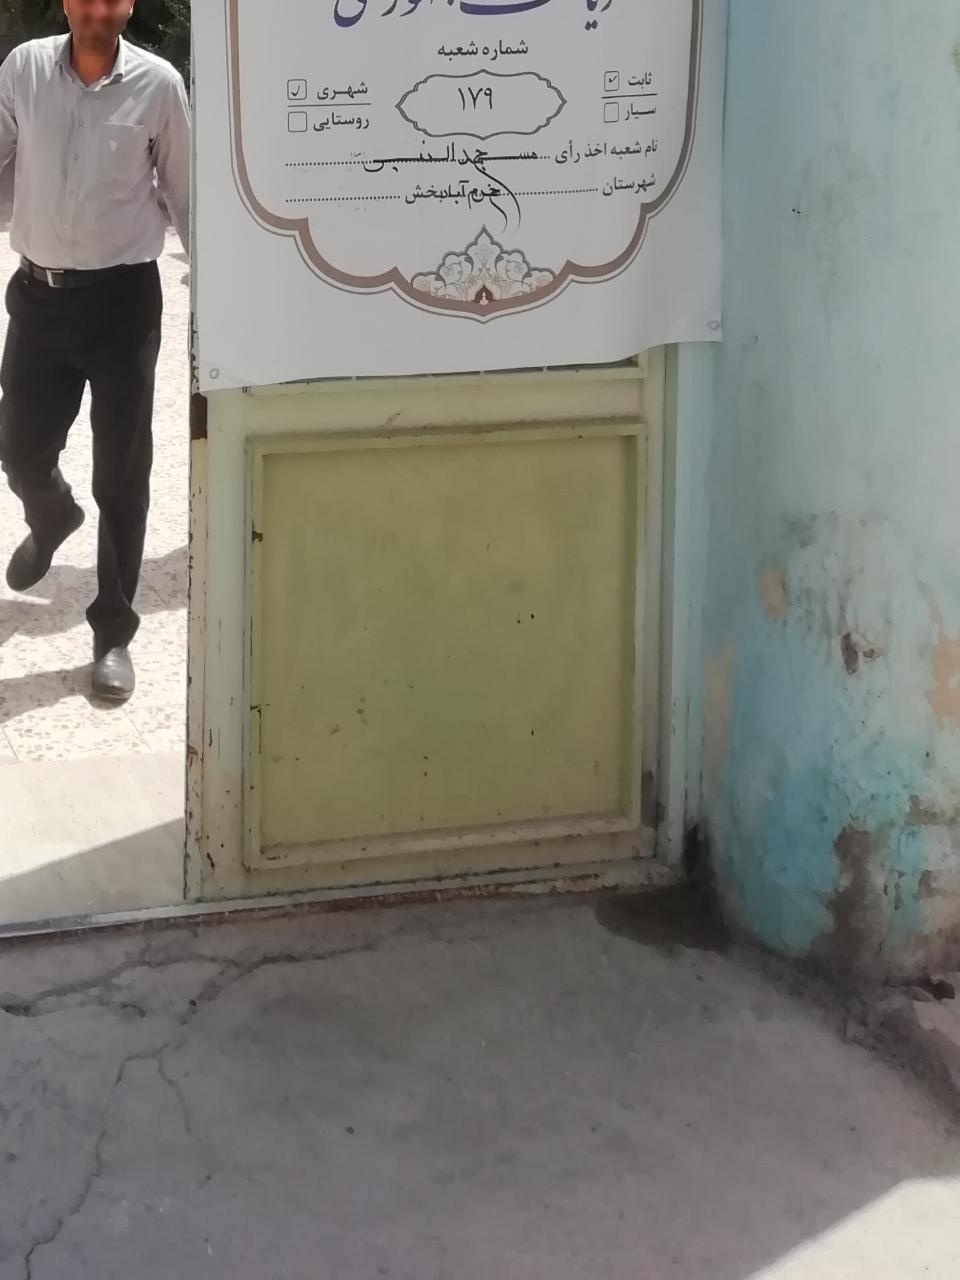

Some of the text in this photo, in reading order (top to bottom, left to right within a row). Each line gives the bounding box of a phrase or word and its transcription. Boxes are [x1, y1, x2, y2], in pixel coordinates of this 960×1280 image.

[437, 39, 529, 62] شماره شعبه
[316, 80, 369, 101] شهری
[628, 72, 653, 90] ثابت
[457, 84, 494, 112] ۱۷۹
[624, 101, 657, 120] سیار
[312, 111, 370, 132] روستایی
[554, 139, 581, 164] رأی
[583, 142, 607, 158] اخذ
[610, 140, 642, 160] شعبه
[644, 138, 659, 159] نام
[601, 173, 657, 197] شهرستان
